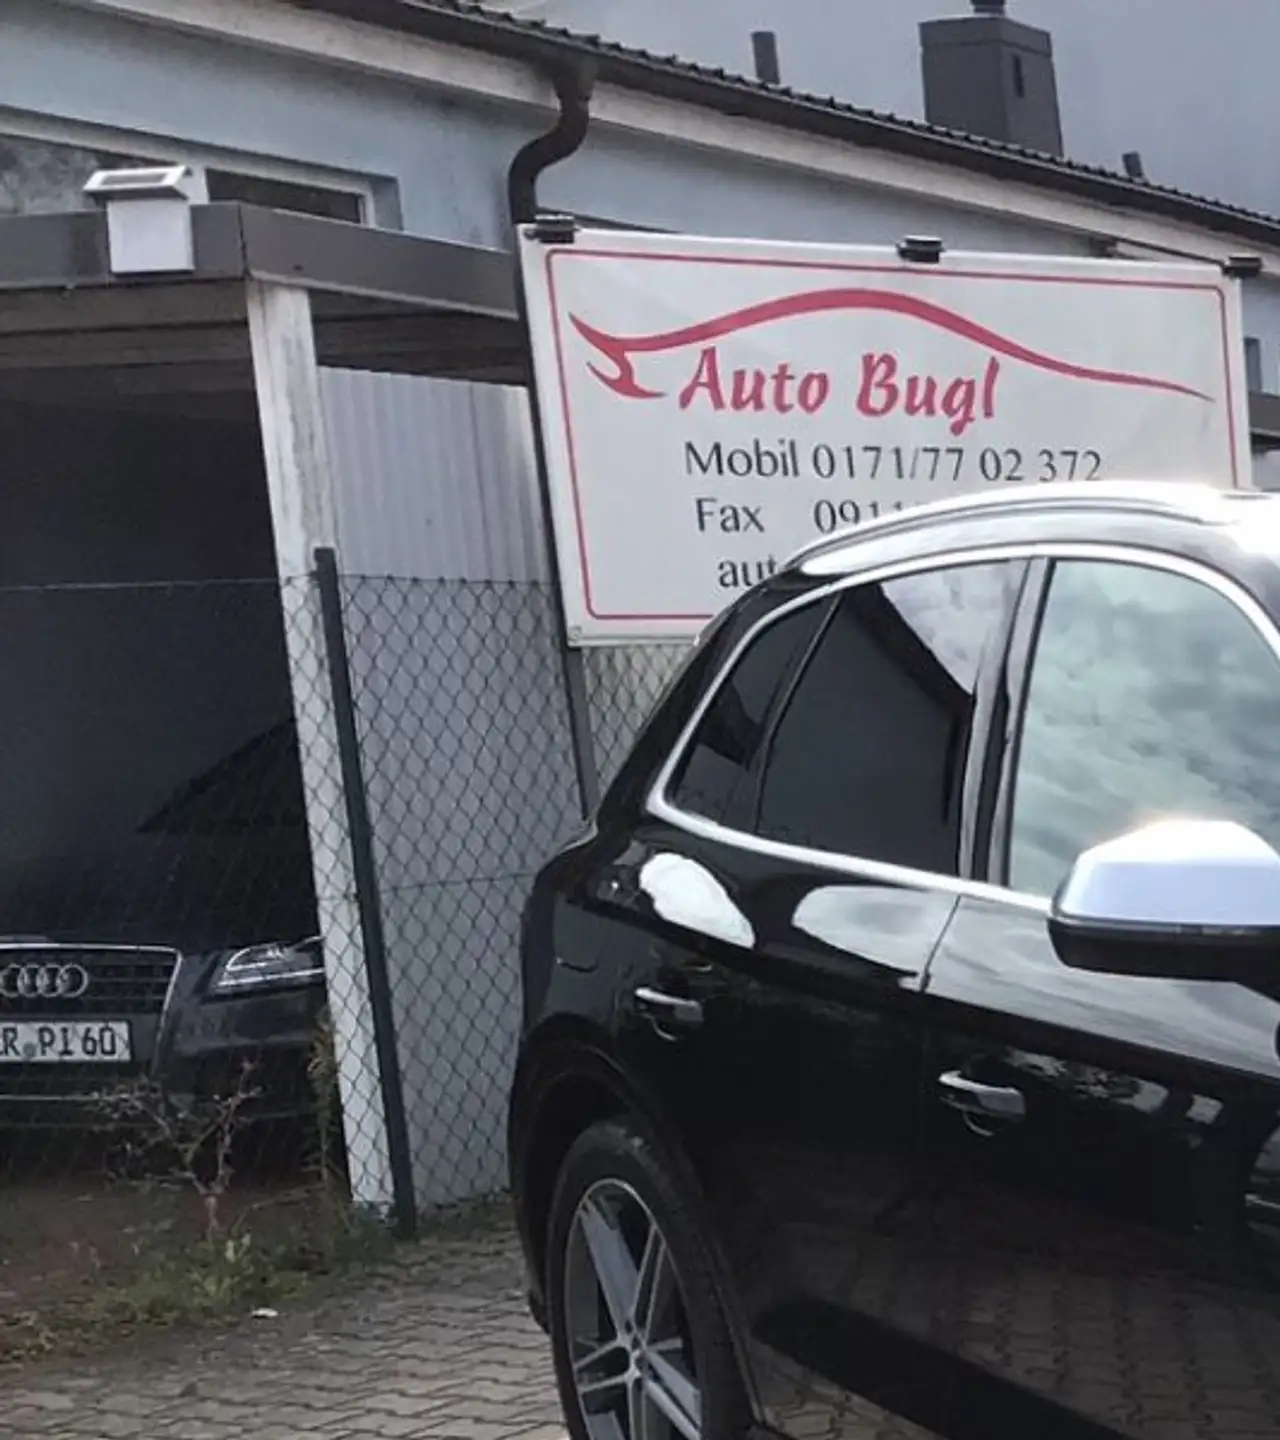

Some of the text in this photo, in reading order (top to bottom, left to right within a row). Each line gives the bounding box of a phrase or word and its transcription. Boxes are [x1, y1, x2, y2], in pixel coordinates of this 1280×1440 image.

[678, 346, 1000, 436] Auto Bugl
[685, 438, 1102, 483] Mobil 0171/77 02 372
[695, 497, 906, 534] Fax 091
[0, 1027, 20, 1056] R
[82, 1027, 116, 1056] 60
